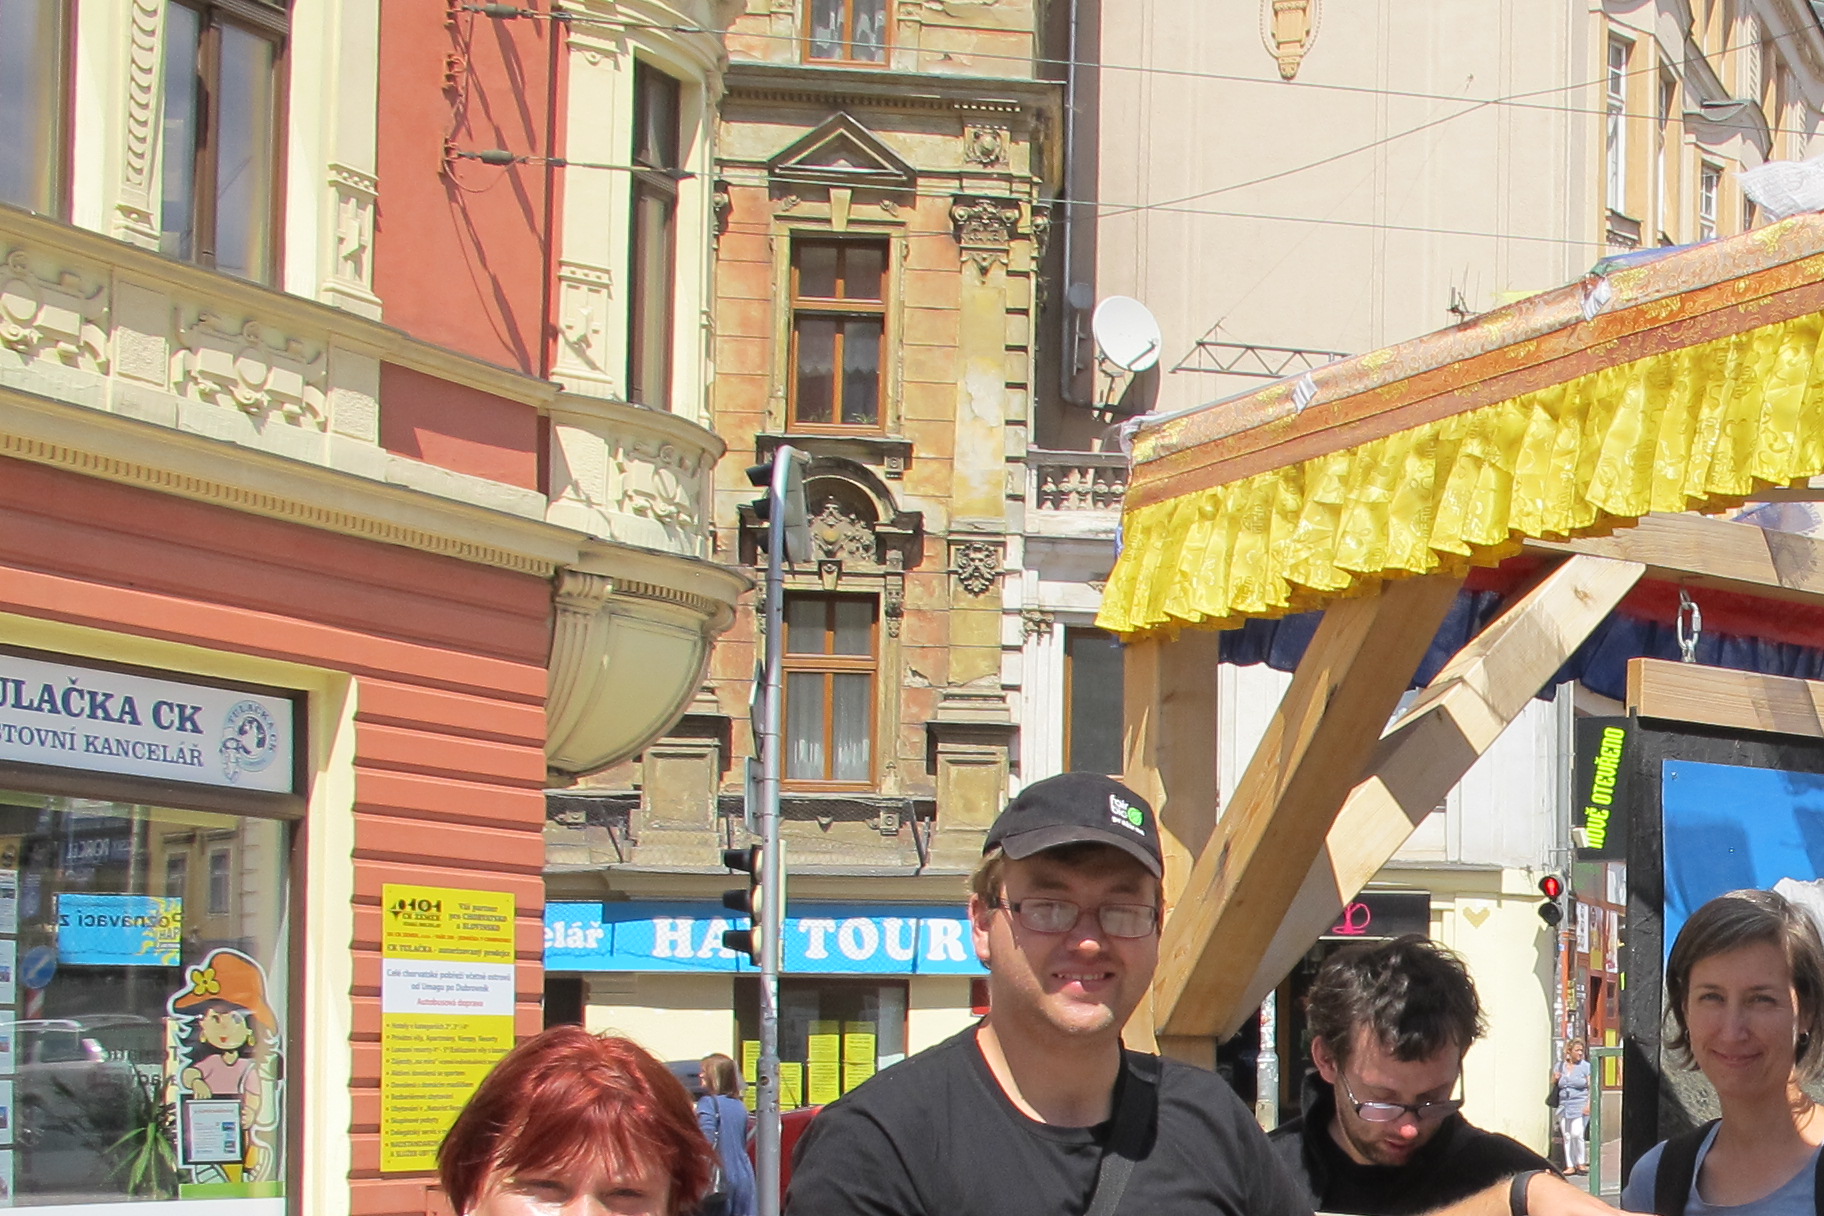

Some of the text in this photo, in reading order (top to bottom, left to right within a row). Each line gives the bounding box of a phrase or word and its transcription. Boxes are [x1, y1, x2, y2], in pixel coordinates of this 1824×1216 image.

[152, 700, 204, 735] CK
[0, 722, 204, 768] TOVNÍ KANCELÁŘ
[651, 915, 752, 959] HA
[798, 916, 968, 962] TOUR
